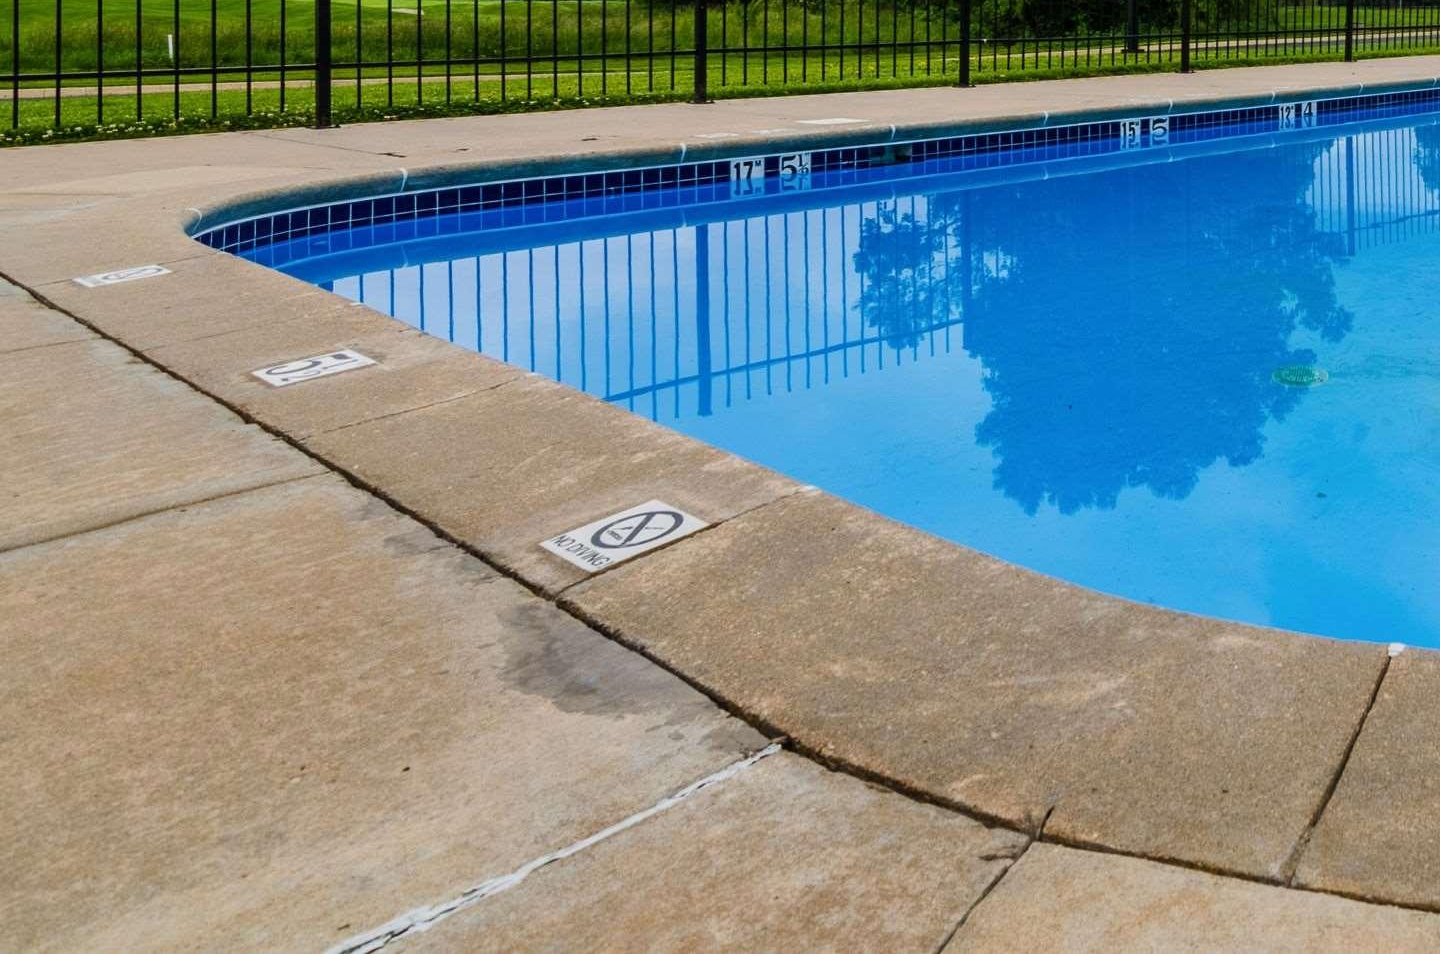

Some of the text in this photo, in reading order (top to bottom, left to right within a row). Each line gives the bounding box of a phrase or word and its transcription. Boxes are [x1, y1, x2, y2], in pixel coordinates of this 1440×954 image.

[1304, 102, 1313, 118] 4
[1152, 118, 1167, 137] 5
[565, 543, 611, 567] DIVING
